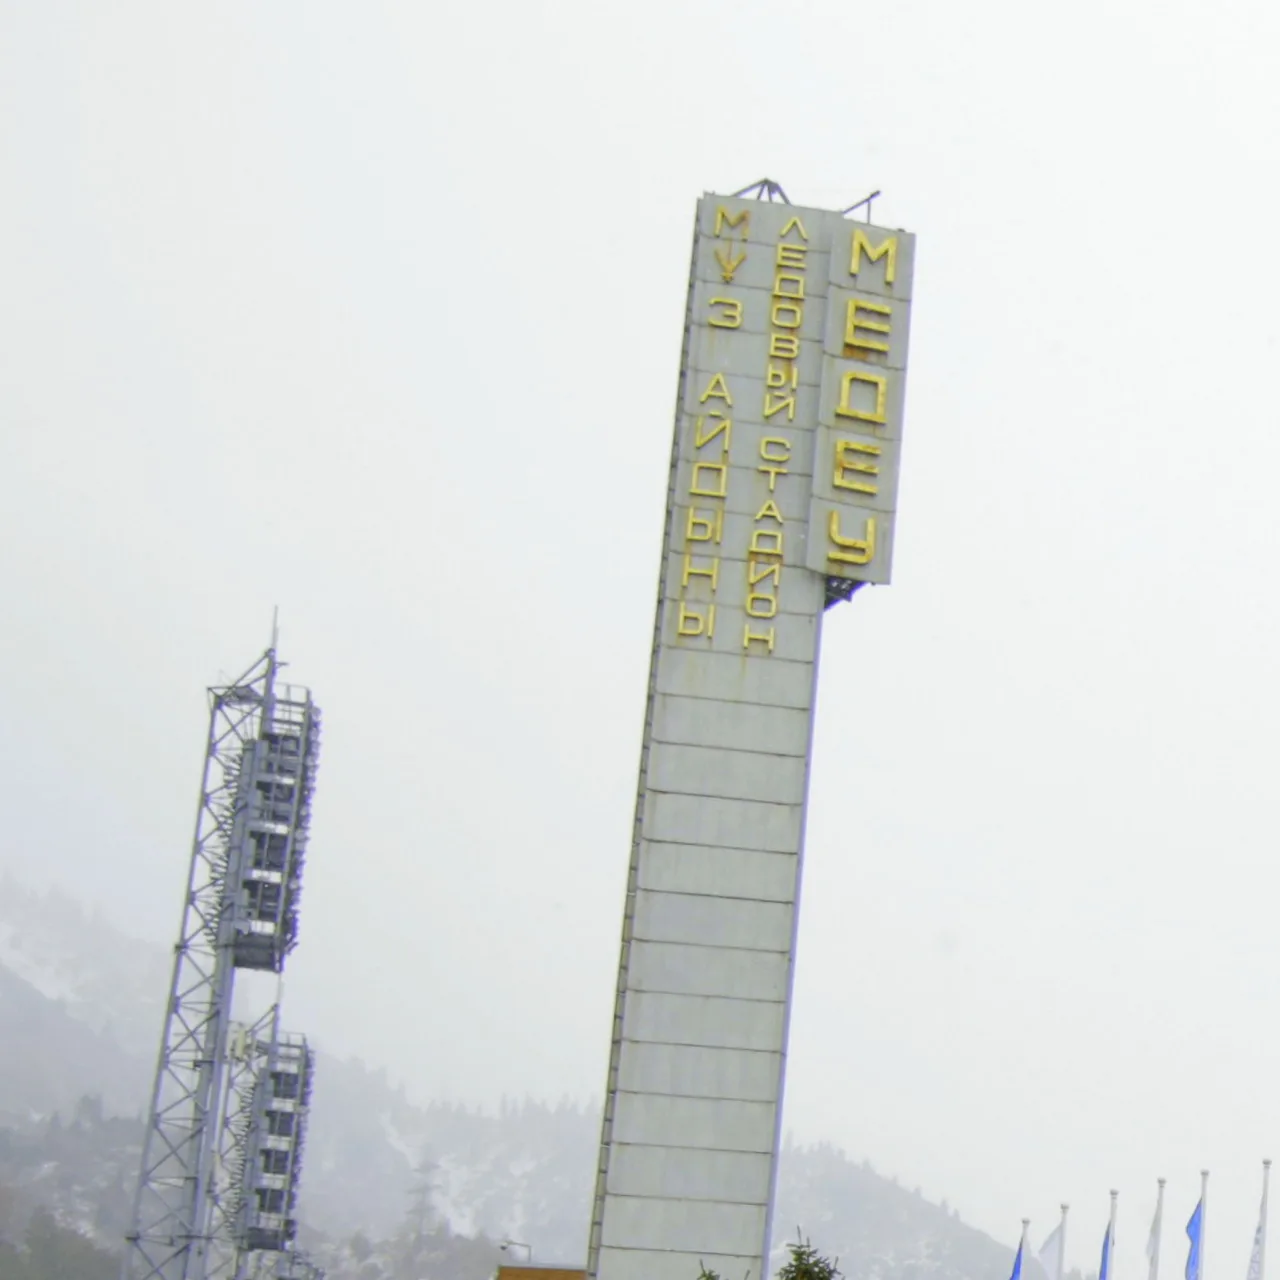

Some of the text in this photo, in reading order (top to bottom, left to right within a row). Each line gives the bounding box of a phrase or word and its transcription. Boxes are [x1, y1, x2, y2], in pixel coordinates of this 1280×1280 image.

[677, 371, 733, 638] АЙДЫНЫ
[742, 216, 808, 653] ЛЕДОВЫЙ СТАДИОН
[826, 228, 898, 565] МЕДЕУ
